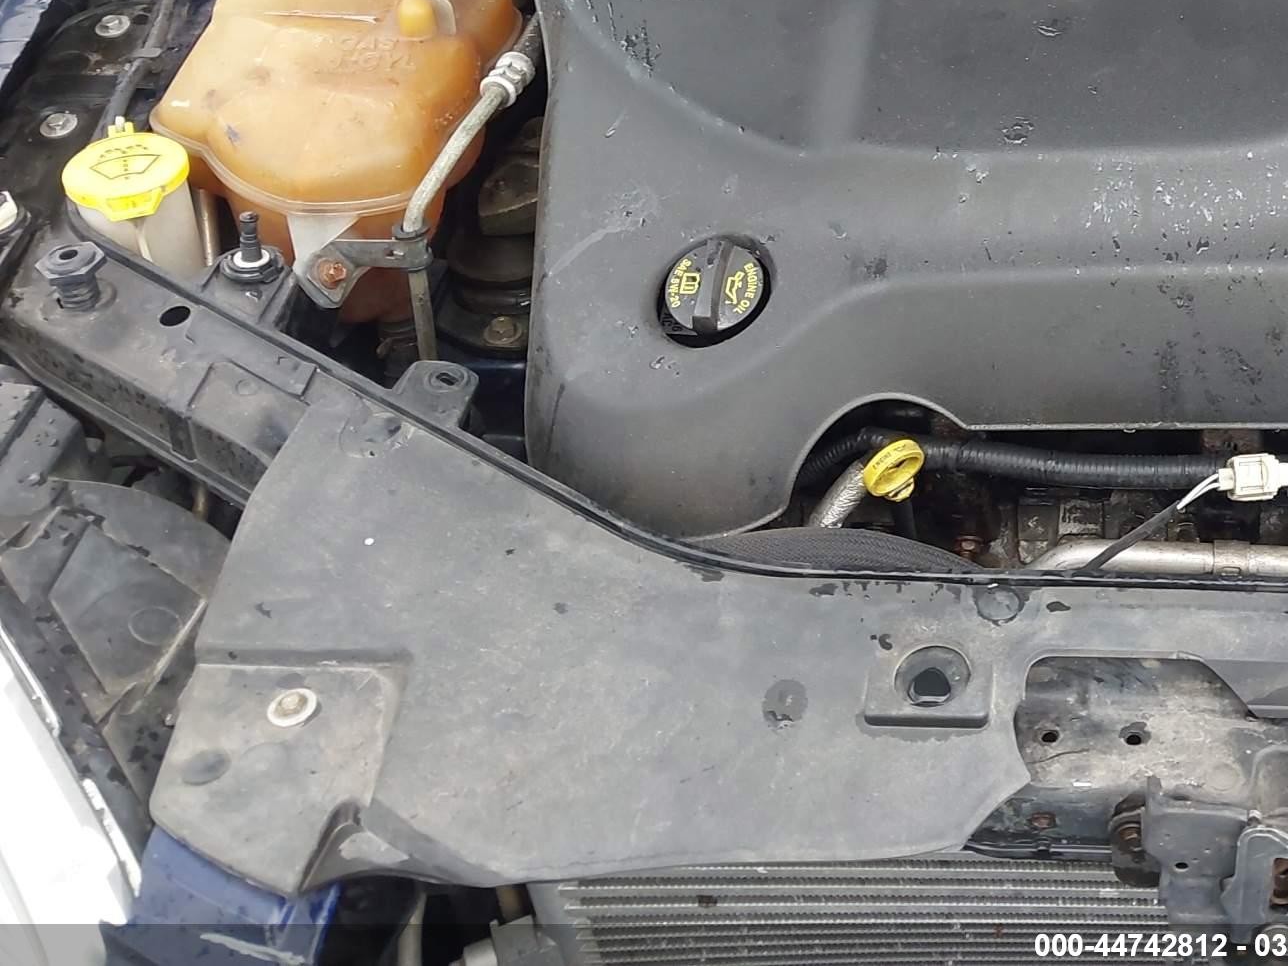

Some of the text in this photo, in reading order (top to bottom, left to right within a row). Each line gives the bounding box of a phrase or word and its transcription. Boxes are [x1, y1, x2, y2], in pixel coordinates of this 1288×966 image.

[674, 258, 692, 278] SAE
[732, 262, 759, 314] ENGINE OIL
